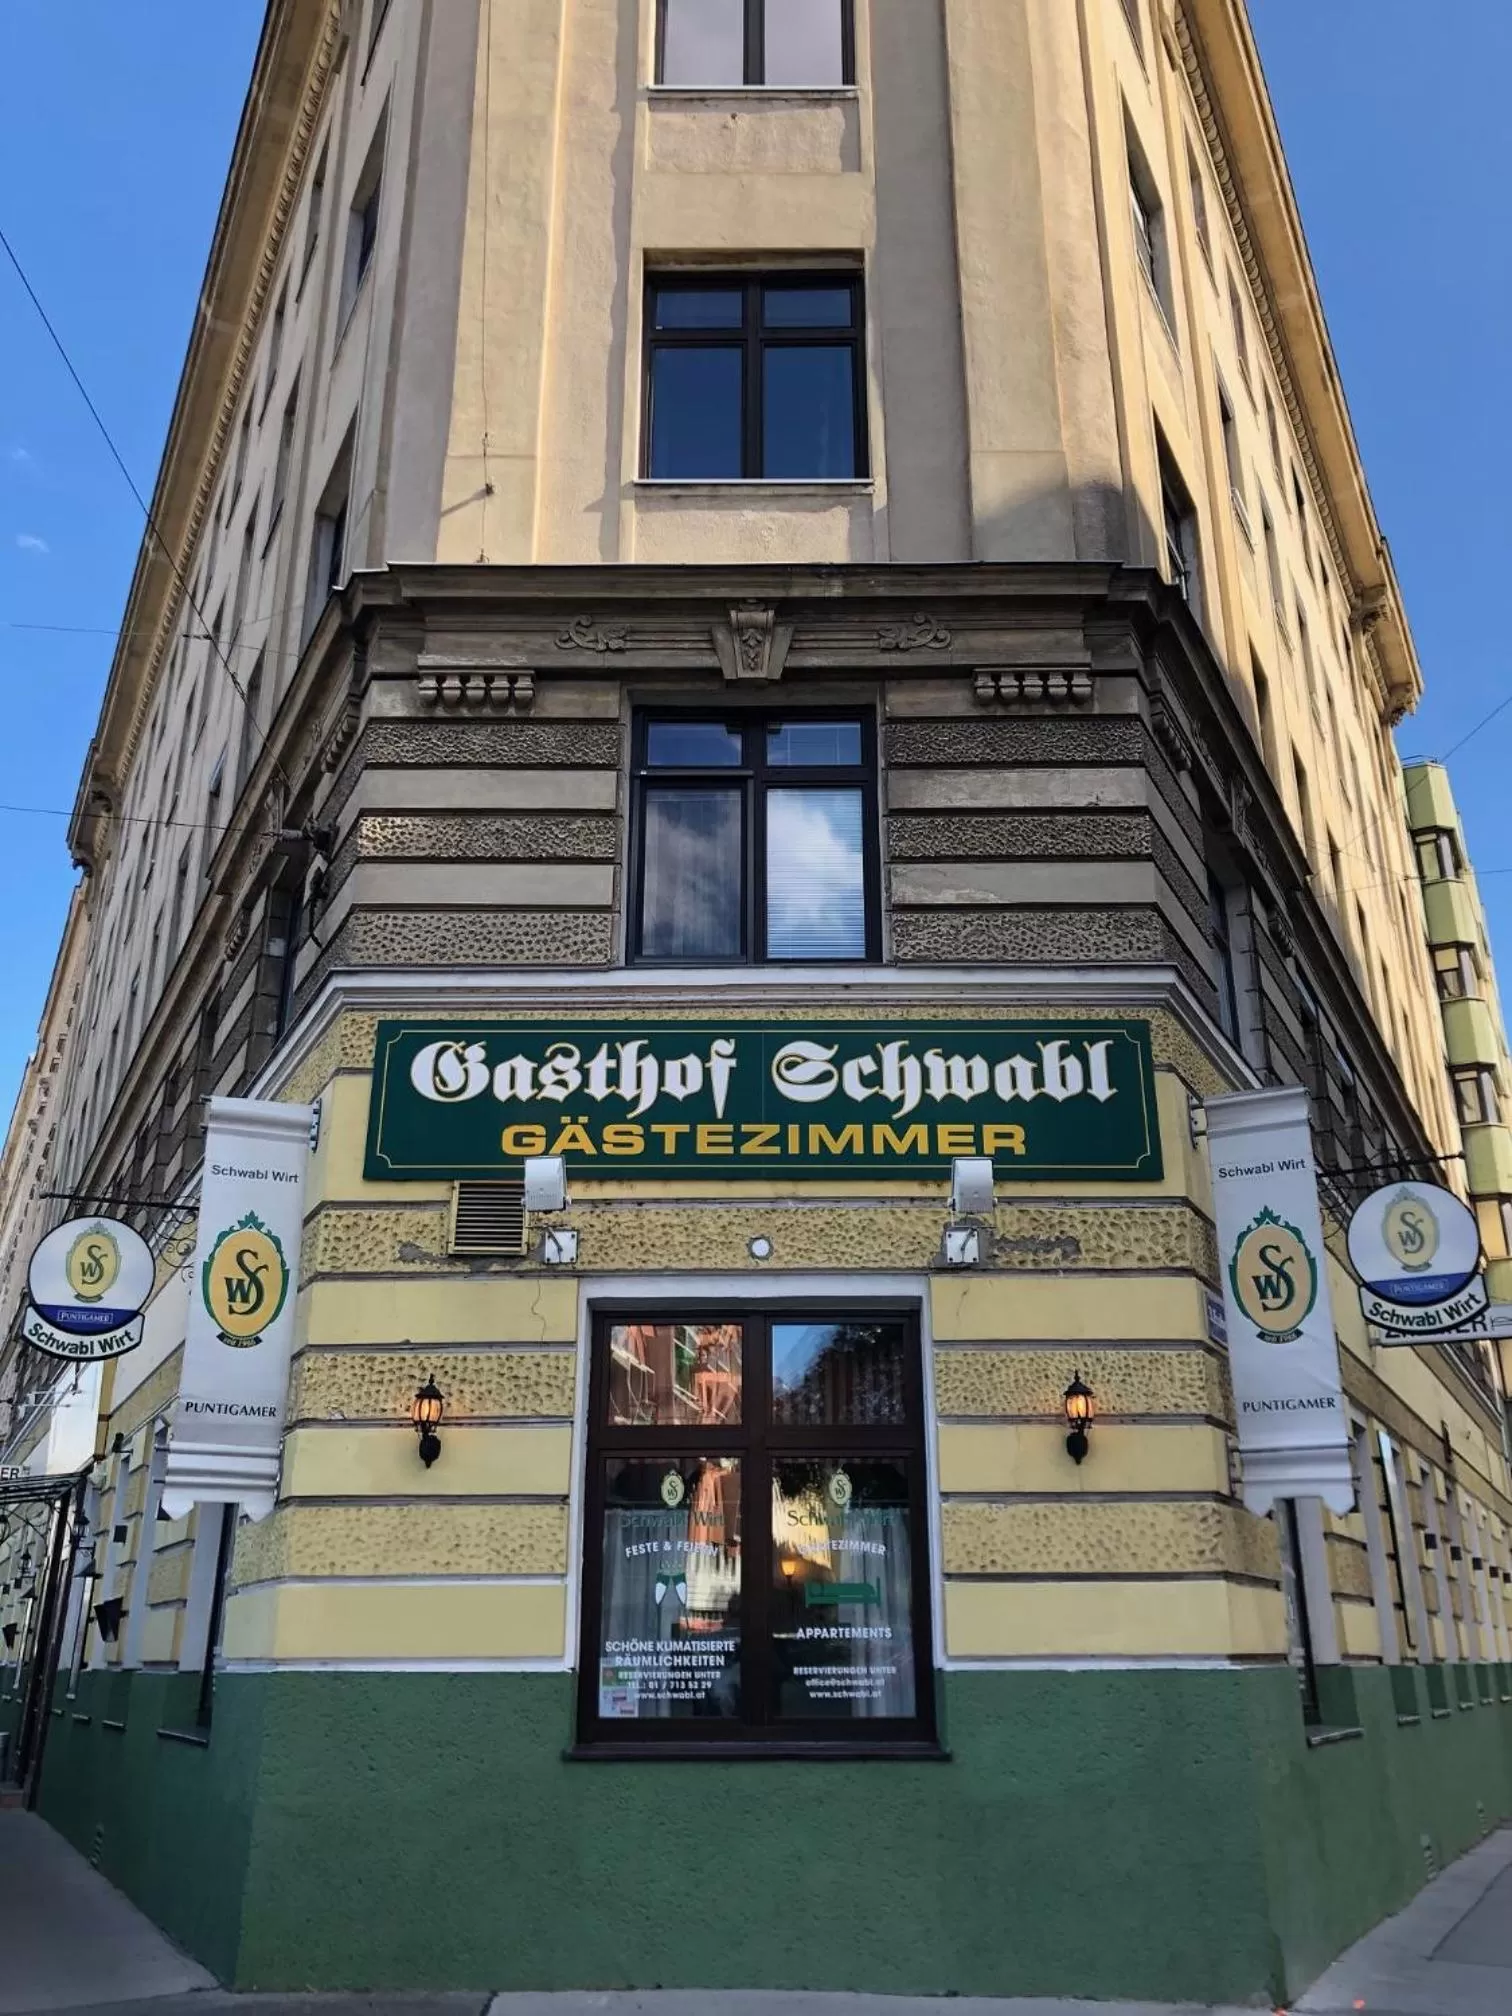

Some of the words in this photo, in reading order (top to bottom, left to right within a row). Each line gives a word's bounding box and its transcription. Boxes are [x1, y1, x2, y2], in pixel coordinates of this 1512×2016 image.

[411, 1038, 737, 1120] Gasthof
[771, 1038, 1119, 1121] Schwabl
[501, 1116, 1027, 1156] GÄSTEZIMMER
[211, 1164, 268, 1180] Schwabl
[272, 1169, 299, 1183] Wirt
[1218, 1162, 1275, 1178] Schwabl
[1278, 1158, 1306, 1171] Wirt
[1369, 1301, 1442, 1328] Schwabl
[1444, 1292, 1482, 1321] Wirt
[28, 1322, 95, 1356] Schwabl
[98, 1330, 134, 1353] Wirt
[185, 1401, 277, 1417] PUNTIGAMER
[1242, 1397, 1336, 1412] PUNTIGAMER
[625, 1541, 659, 1558] FESTE
[663, 1541, 672, 1552] &
[796, 1627, 892, 1640] APPARTEMENTS
[605, 1637, 654, 1652] SCHÖNE
[614, 1653, 726, 1667] RÄUMLICHKEITEN
